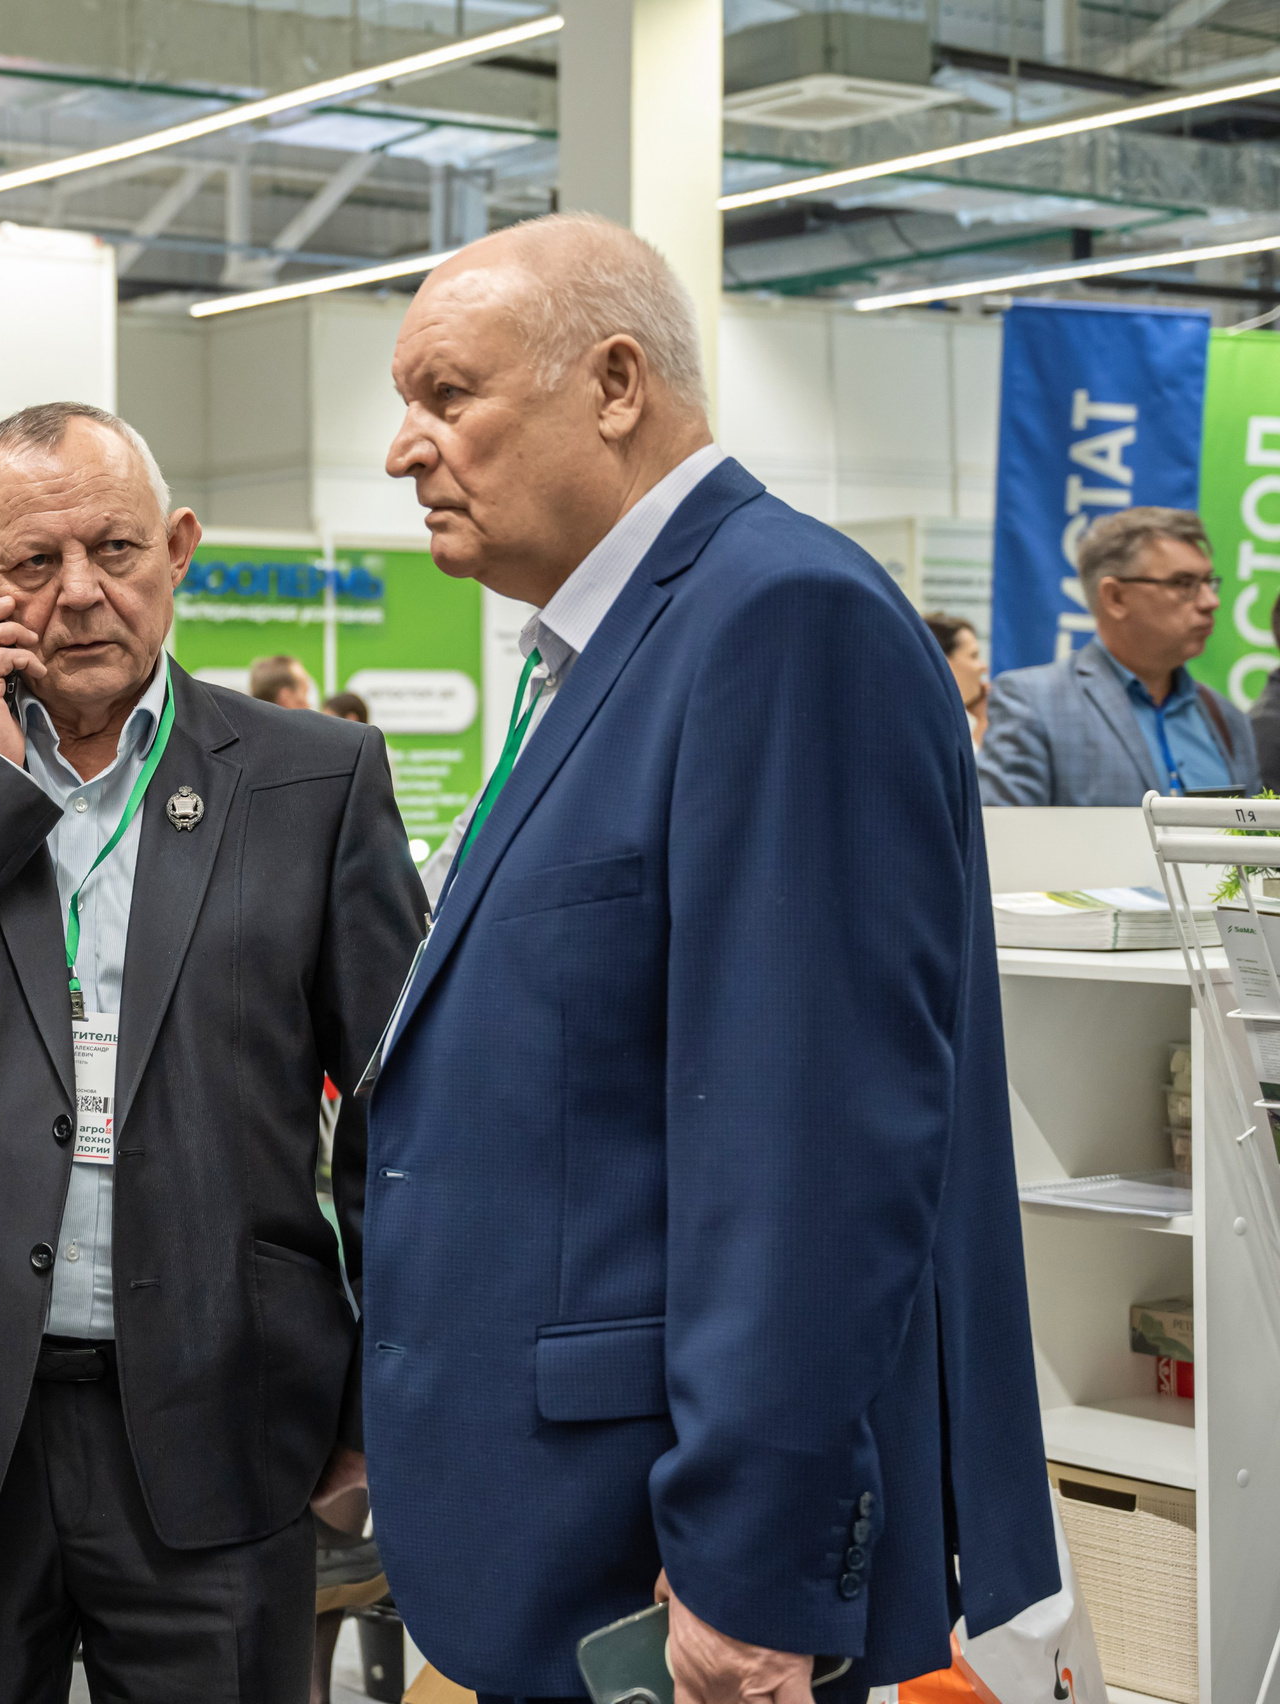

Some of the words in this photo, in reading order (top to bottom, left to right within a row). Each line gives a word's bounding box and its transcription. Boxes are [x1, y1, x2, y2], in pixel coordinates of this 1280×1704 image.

[74, 1045, 110, 1053] АЛЕКСАНДР
[79, 1125, 106, 1135] агро
[78, 1135, 111, 1144] техно
[76, 1145, 110, 1154] логии
